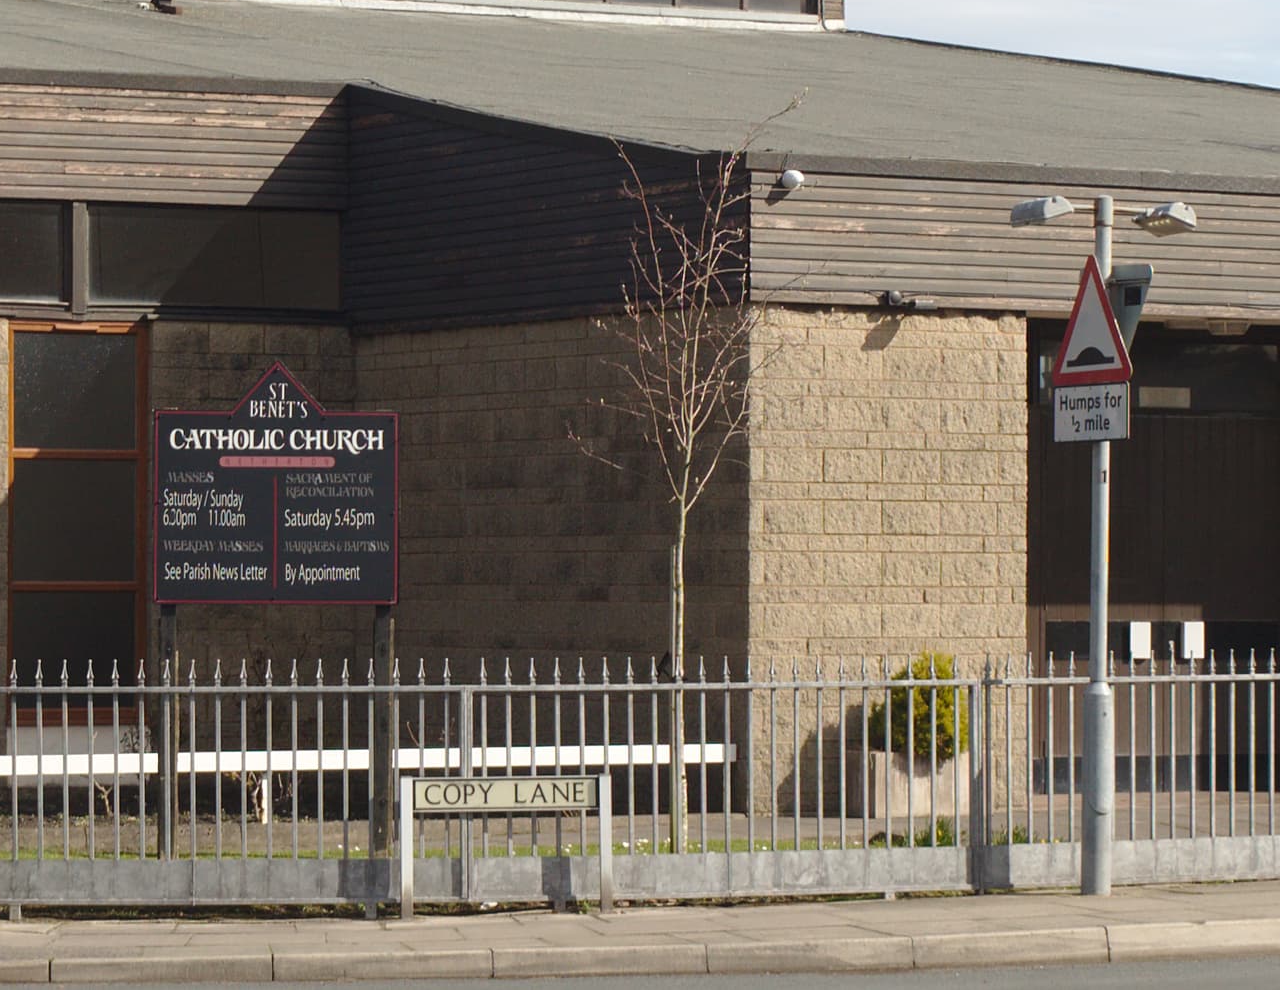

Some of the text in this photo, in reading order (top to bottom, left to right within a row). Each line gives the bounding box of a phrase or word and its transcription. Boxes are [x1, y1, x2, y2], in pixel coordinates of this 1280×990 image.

[269, 382, 288, 400] ST
[250, 400, 308, 418] BENET'S
[1060, 391, 1122, 412] Humps for
[1084, 414, 1110, 431] mile
[170, 428, 385, 455] CATHOLIC CHURCH
[286, 472, 373, 486] SACRAMENT OF
[163, 488, 202, 511] Saturday
[210, 489, 244, 512] Sunday
[208, 509, 246, 528] 11.00am
[284, 508, 375, 530] Saturday 5.45pm
[163, 539, 215, 554] WEEKDAY
[164, 562, 268, 581] See Parish News Letter
[285, 563, 360, 586] By Appointment
[424, 782, 585, 805] COPY LANE
